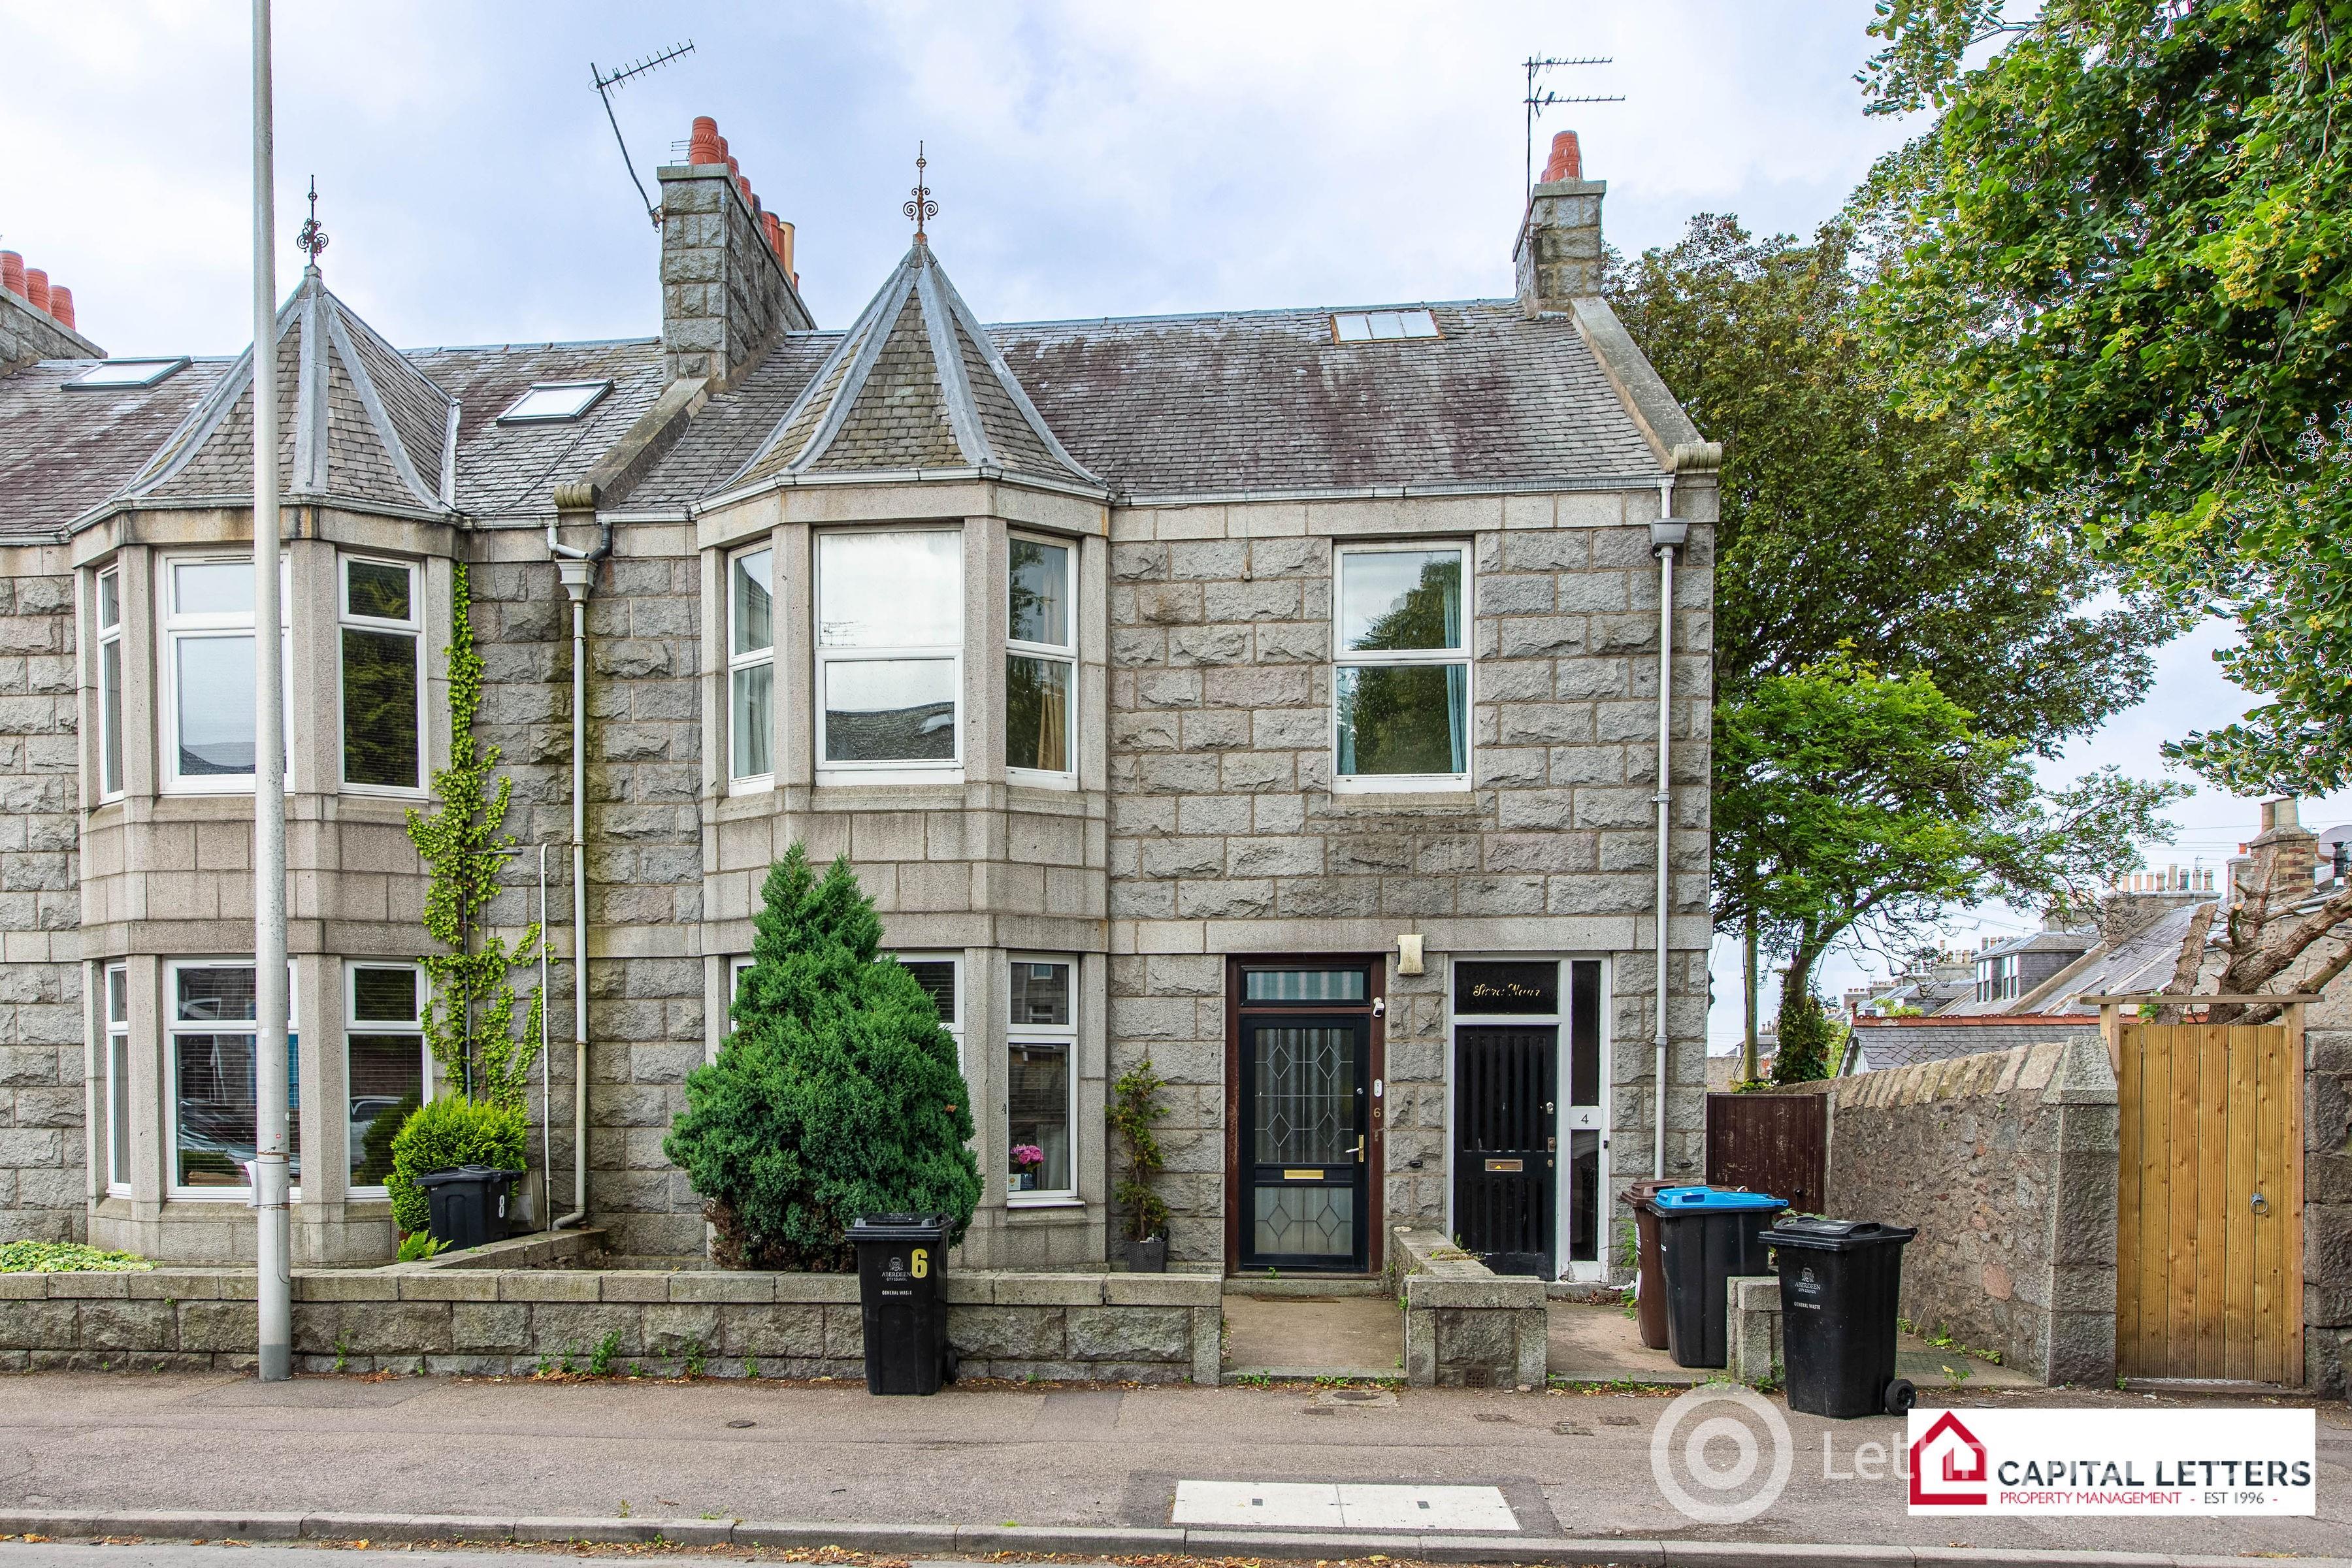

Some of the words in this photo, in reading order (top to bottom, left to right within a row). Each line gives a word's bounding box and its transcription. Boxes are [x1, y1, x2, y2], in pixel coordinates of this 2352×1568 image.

[1373, 1107, 1381, 1118] 6
[1581, 1114, 1589, 1124] 4
[498, 1195, 505, 1218] 8
[911, 1249, 927, 1279] 6
[1795, 1281, 1821, 1290] ABERDEEN
